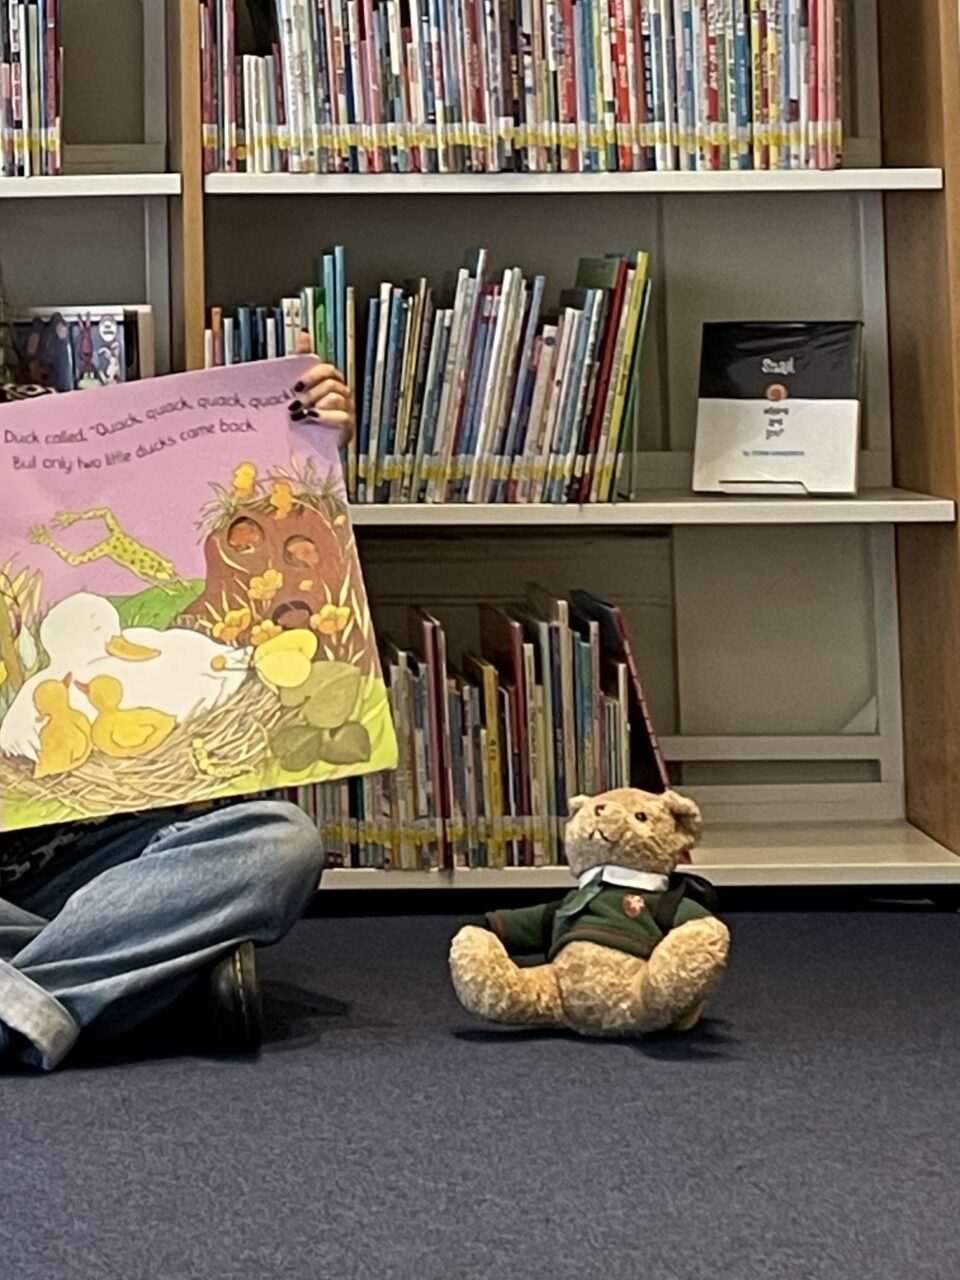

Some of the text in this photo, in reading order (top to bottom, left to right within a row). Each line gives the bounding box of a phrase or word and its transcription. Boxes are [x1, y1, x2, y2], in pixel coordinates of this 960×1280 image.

[4, 429, 39, 444] Duck
[12, 455, 36, 471] But
[42, 456, 73, 475] only
[77, 457, 102, 469] two
[104, 450, 132, 467] little
[135, 434, 177, 459] ducks
[179, 422, 215, 442] came
